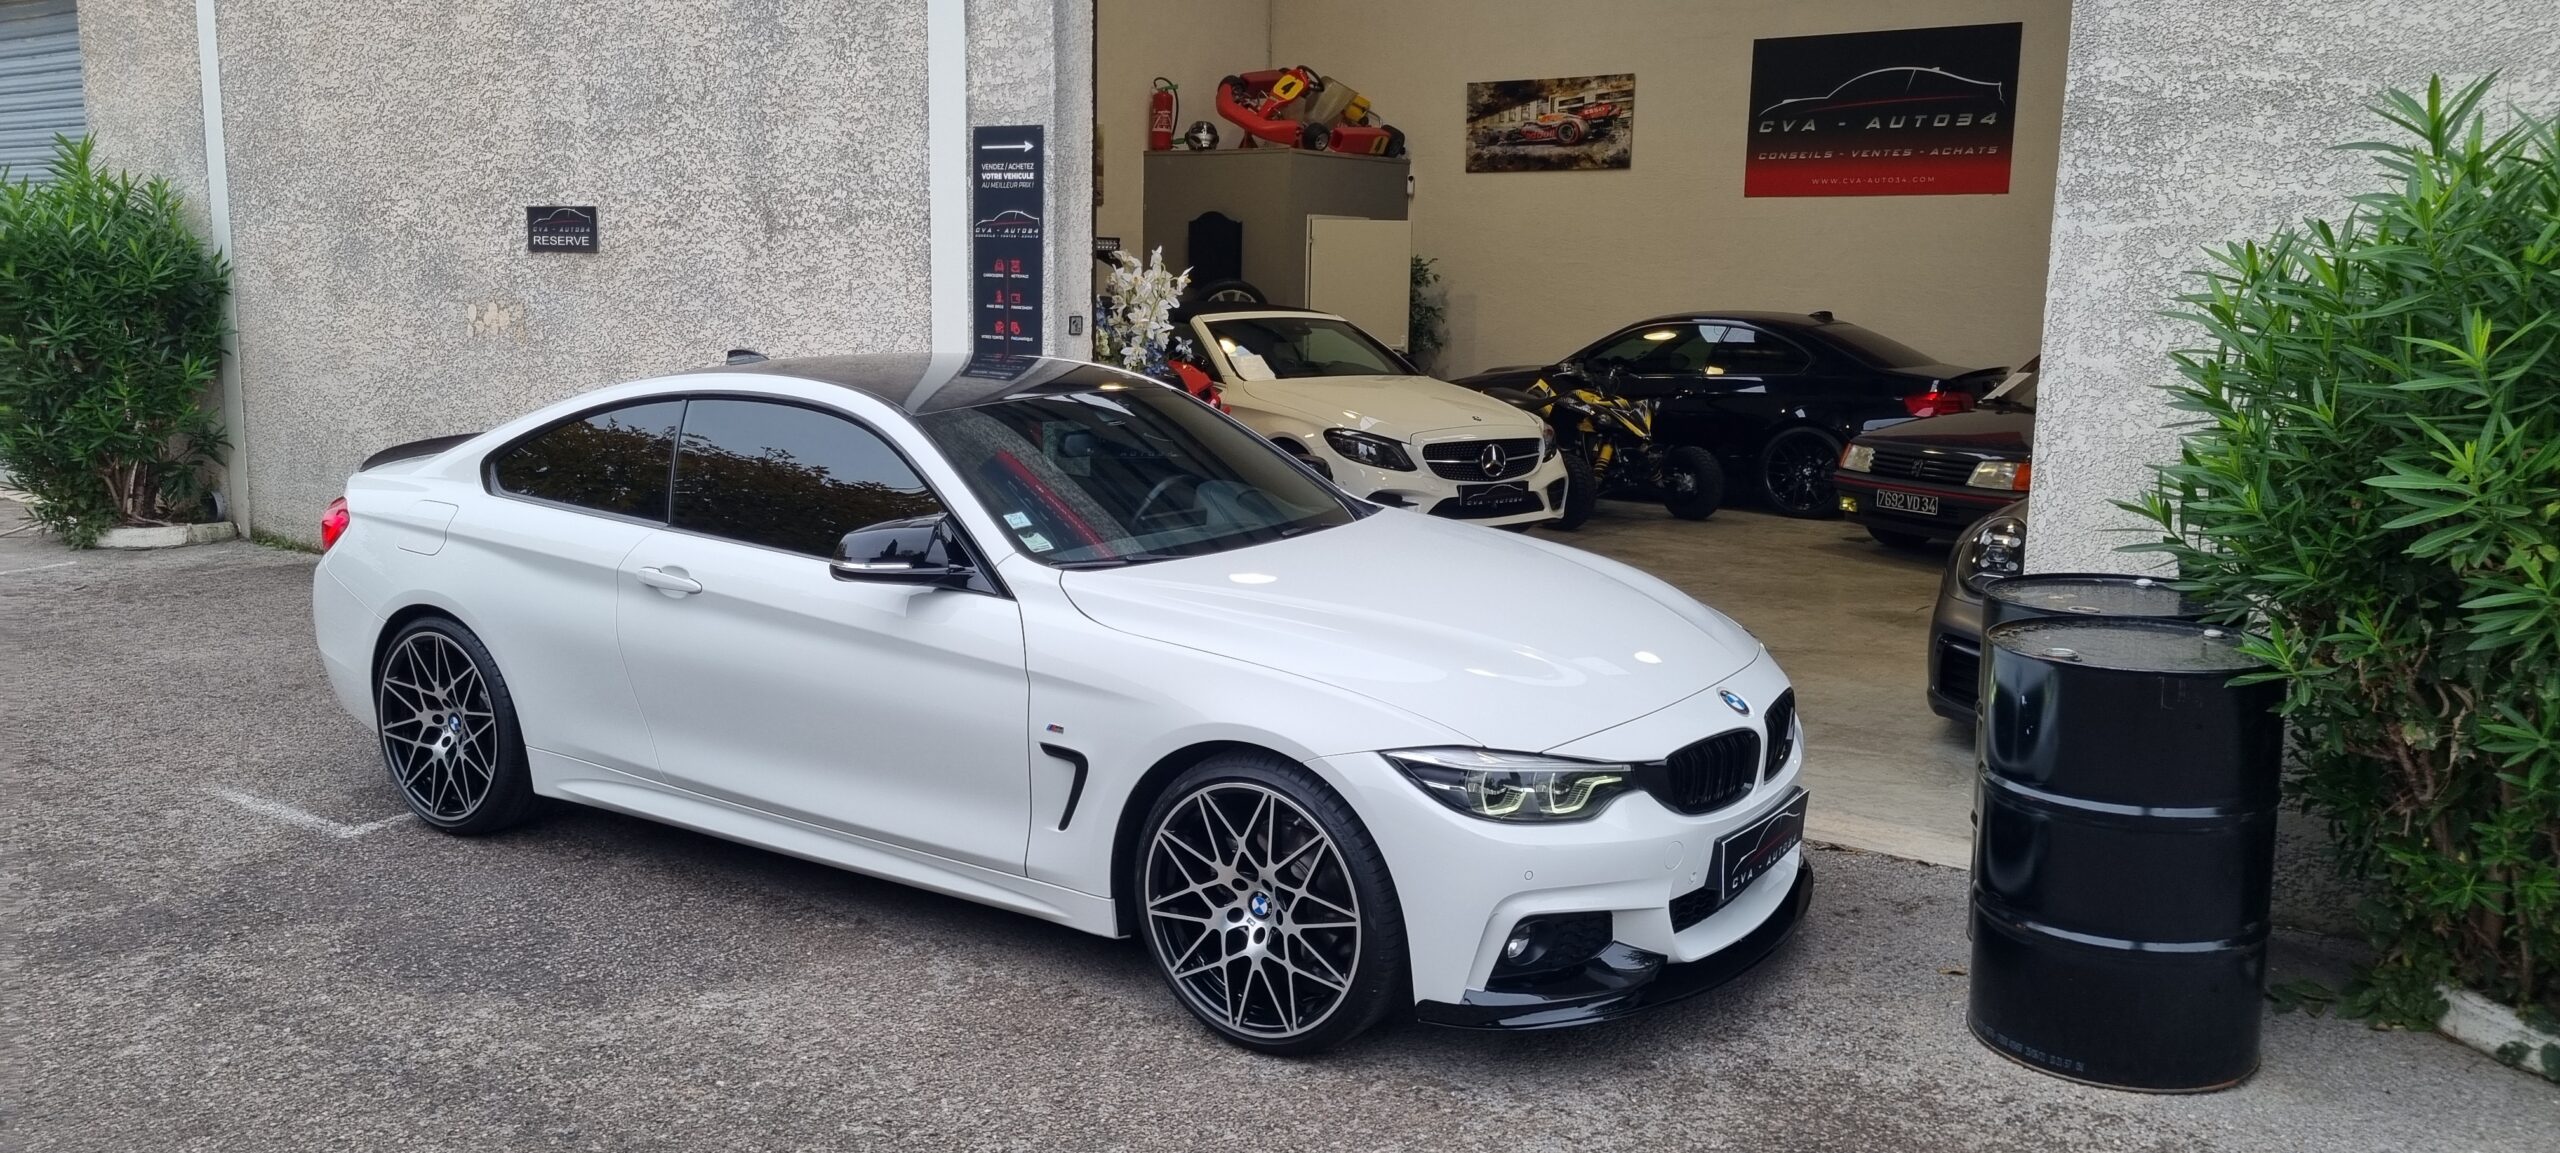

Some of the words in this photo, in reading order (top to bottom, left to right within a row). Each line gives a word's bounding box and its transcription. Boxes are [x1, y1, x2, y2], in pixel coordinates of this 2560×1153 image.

[1759, 119, 1816, 133] CVA
[1865, 112, 1997, 129] AUTO34
[1758, 150, 1834, 160] CONSEILS
[1851, 148, 1913, 158] VENTES
[1929, 146, 1998, 156] ACHATS
[981, 163, 1004, 171] VENDEZ
[1008, 162, 1034, 170] ACHETEZ
[981, 172, 1002, 180] VOTRE
[1003, 172, 1034, 180] VEHICULE
[1811, 176, 1936, 185] WWW.CVA-AUTO34.COM
[533, 235, 590, 246] RESERVE
[1879, 491, 1905, 509] 7692
[1906, 494, 1920, 511] VD
[1921, 496, 1936, 513] 34
[1732, 868, 1754, 889] CVA
